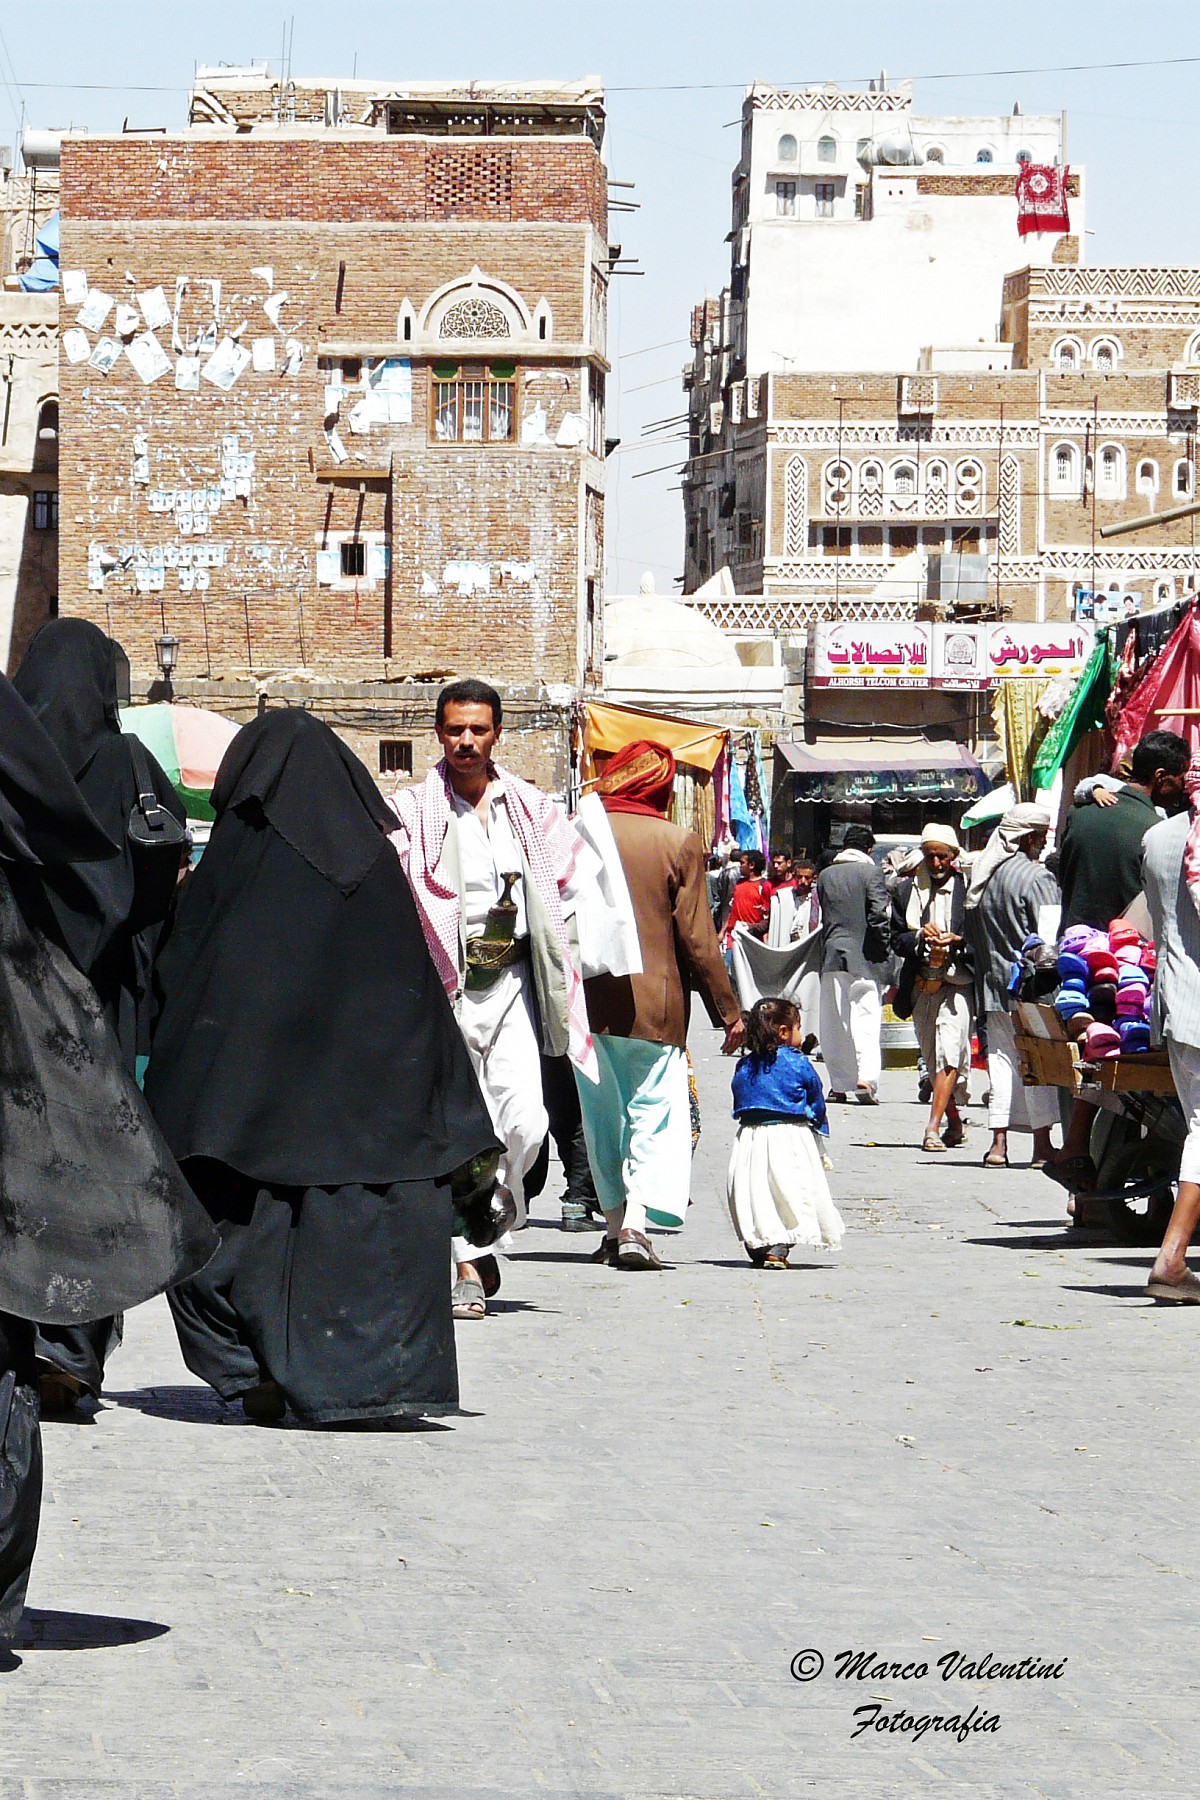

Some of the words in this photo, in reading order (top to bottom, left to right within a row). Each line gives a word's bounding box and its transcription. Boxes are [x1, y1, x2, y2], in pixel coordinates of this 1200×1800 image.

[828, 677, 865, 686] ALHORSH
[865, 677, 897, 687] TELCOM
[899, 678, 928, 687] CENTER
